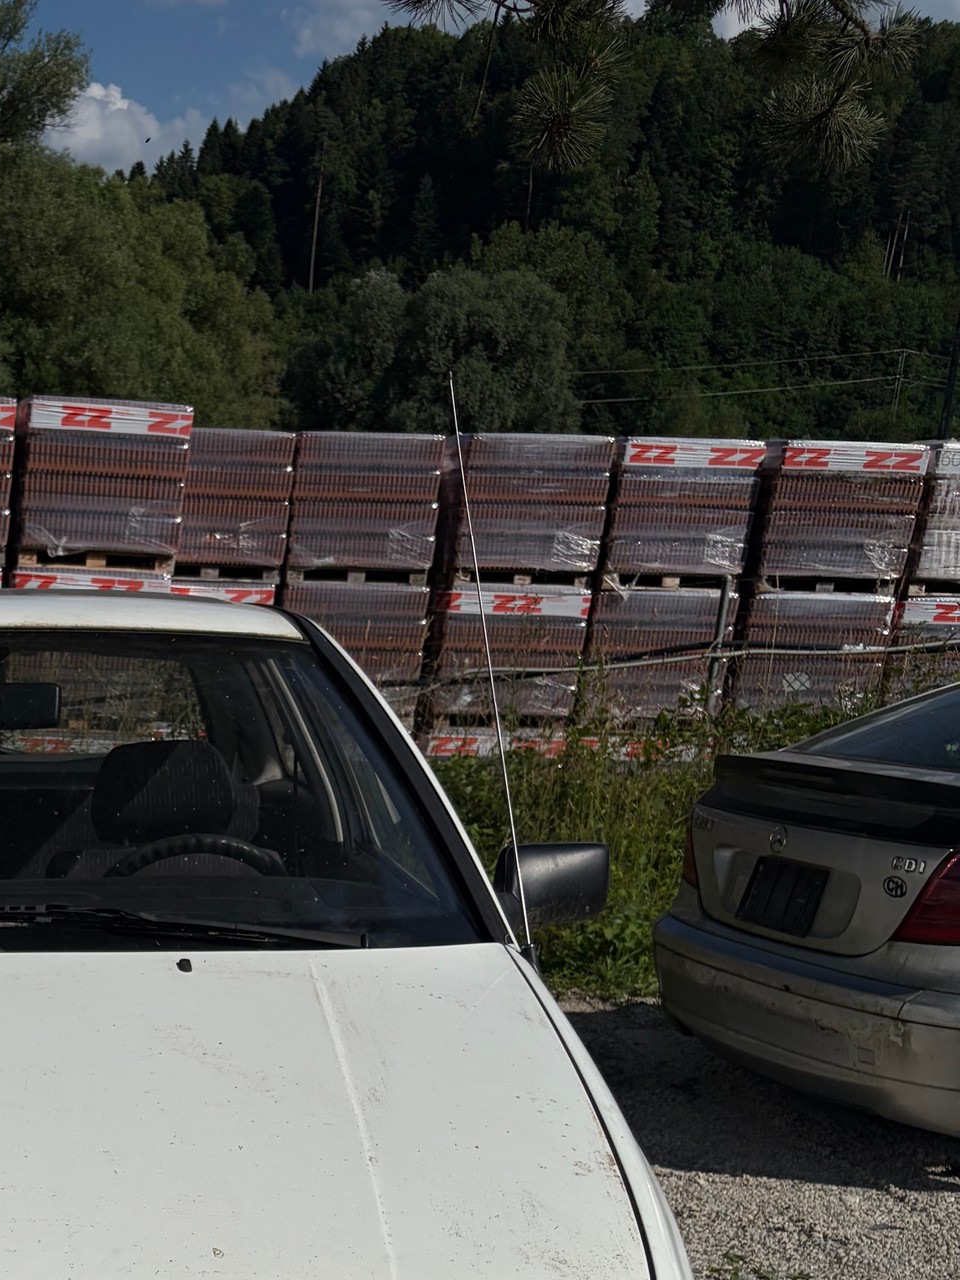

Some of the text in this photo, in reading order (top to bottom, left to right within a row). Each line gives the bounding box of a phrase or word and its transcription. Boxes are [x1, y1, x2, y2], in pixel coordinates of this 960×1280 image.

[60, 405, 112, 429] ZZ
[629, 443, 766, 468] ZZ ZZ
[782, 447, 923, 472] ZZ ZZ
[492, 594, 543, 613] ZZ
[932, 603, 960, 623] Z
[430, 736, 478, 756] ZZ
[892, 855, 927, 874] CDI
[886, 878, 904, 896] CH
